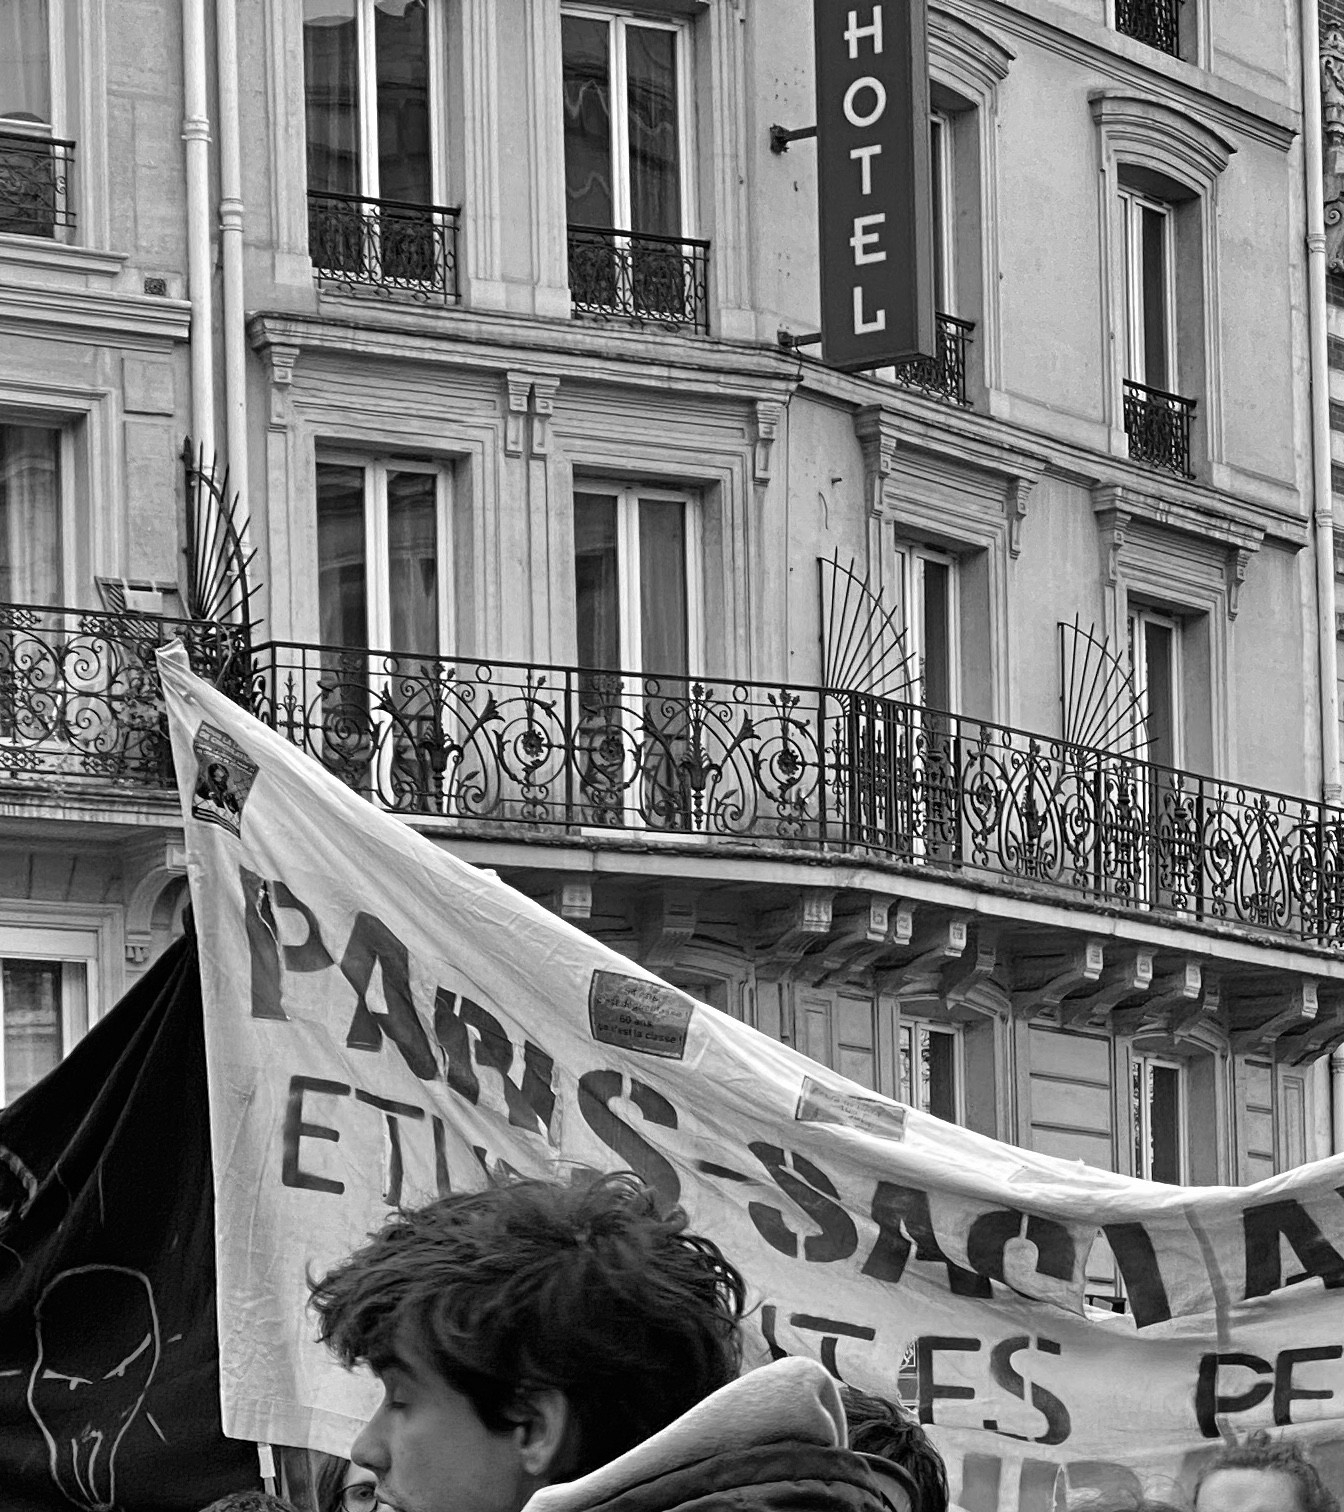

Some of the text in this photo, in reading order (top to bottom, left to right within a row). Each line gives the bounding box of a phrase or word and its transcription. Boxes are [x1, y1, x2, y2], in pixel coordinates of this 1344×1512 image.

[843, 4, 887, 335] HOTEL
[619, 1014, 632, 1025] 60
[645, 1031, 677, 1044] classe
